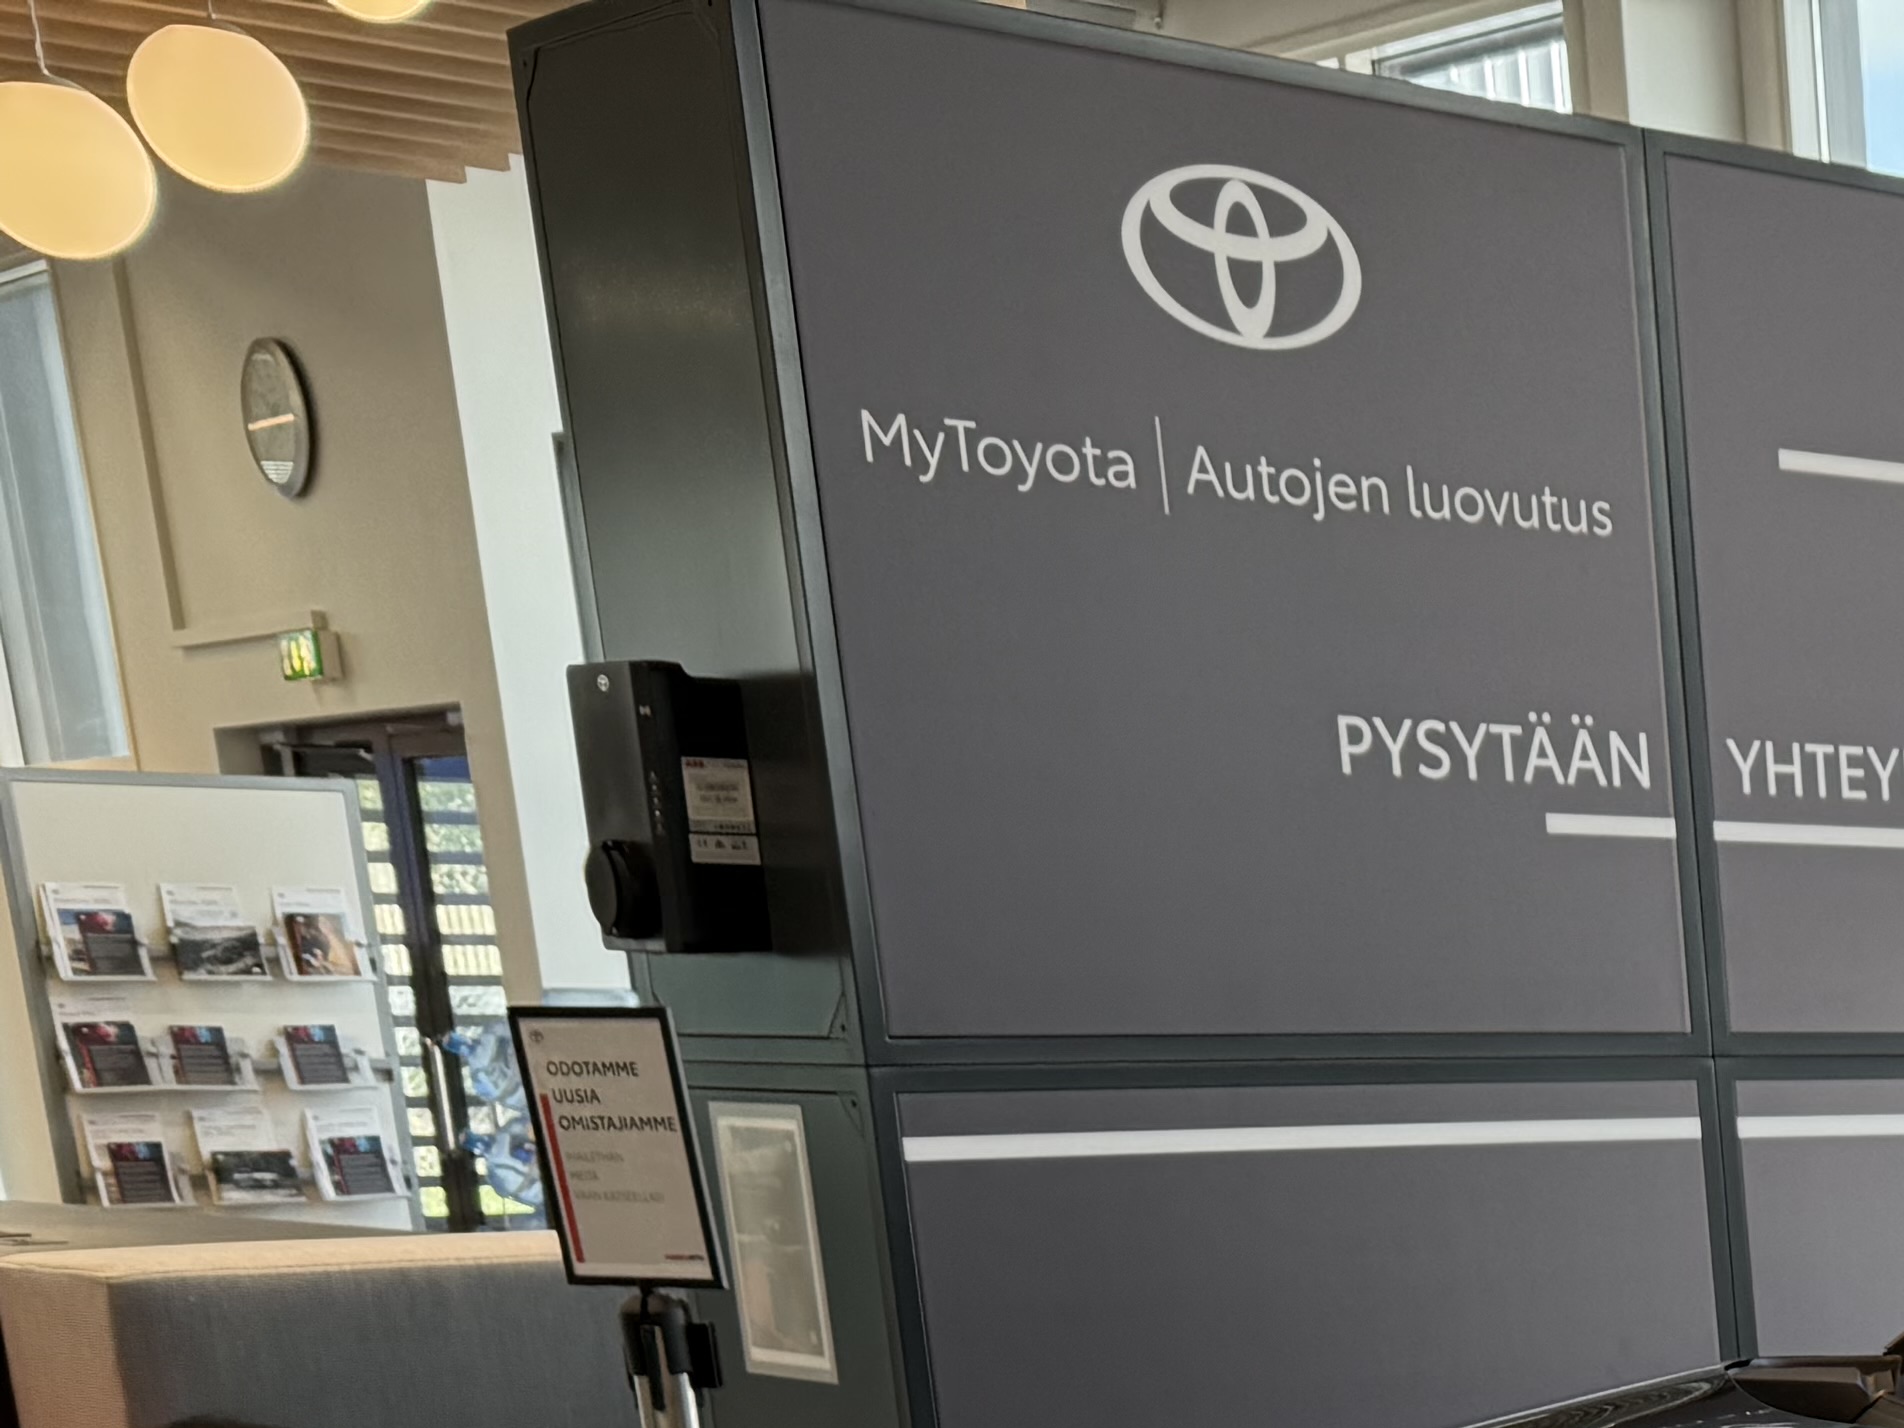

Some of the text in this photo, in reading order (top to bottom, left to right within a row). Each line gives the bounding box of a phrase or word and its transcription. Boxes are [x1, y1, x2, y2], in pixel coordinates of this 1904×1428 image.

[860, 408, 1614, 538] MyToyota Autojen luovutus
[1336, 710, 1652, 791] PYSYTÄÄN
[546, 1060, 640, 1078] ODOTAMME
[551, 1088, 602, 1105] UUSIA
[558, 1115, 678, 1133] OMISTAJIAMME
